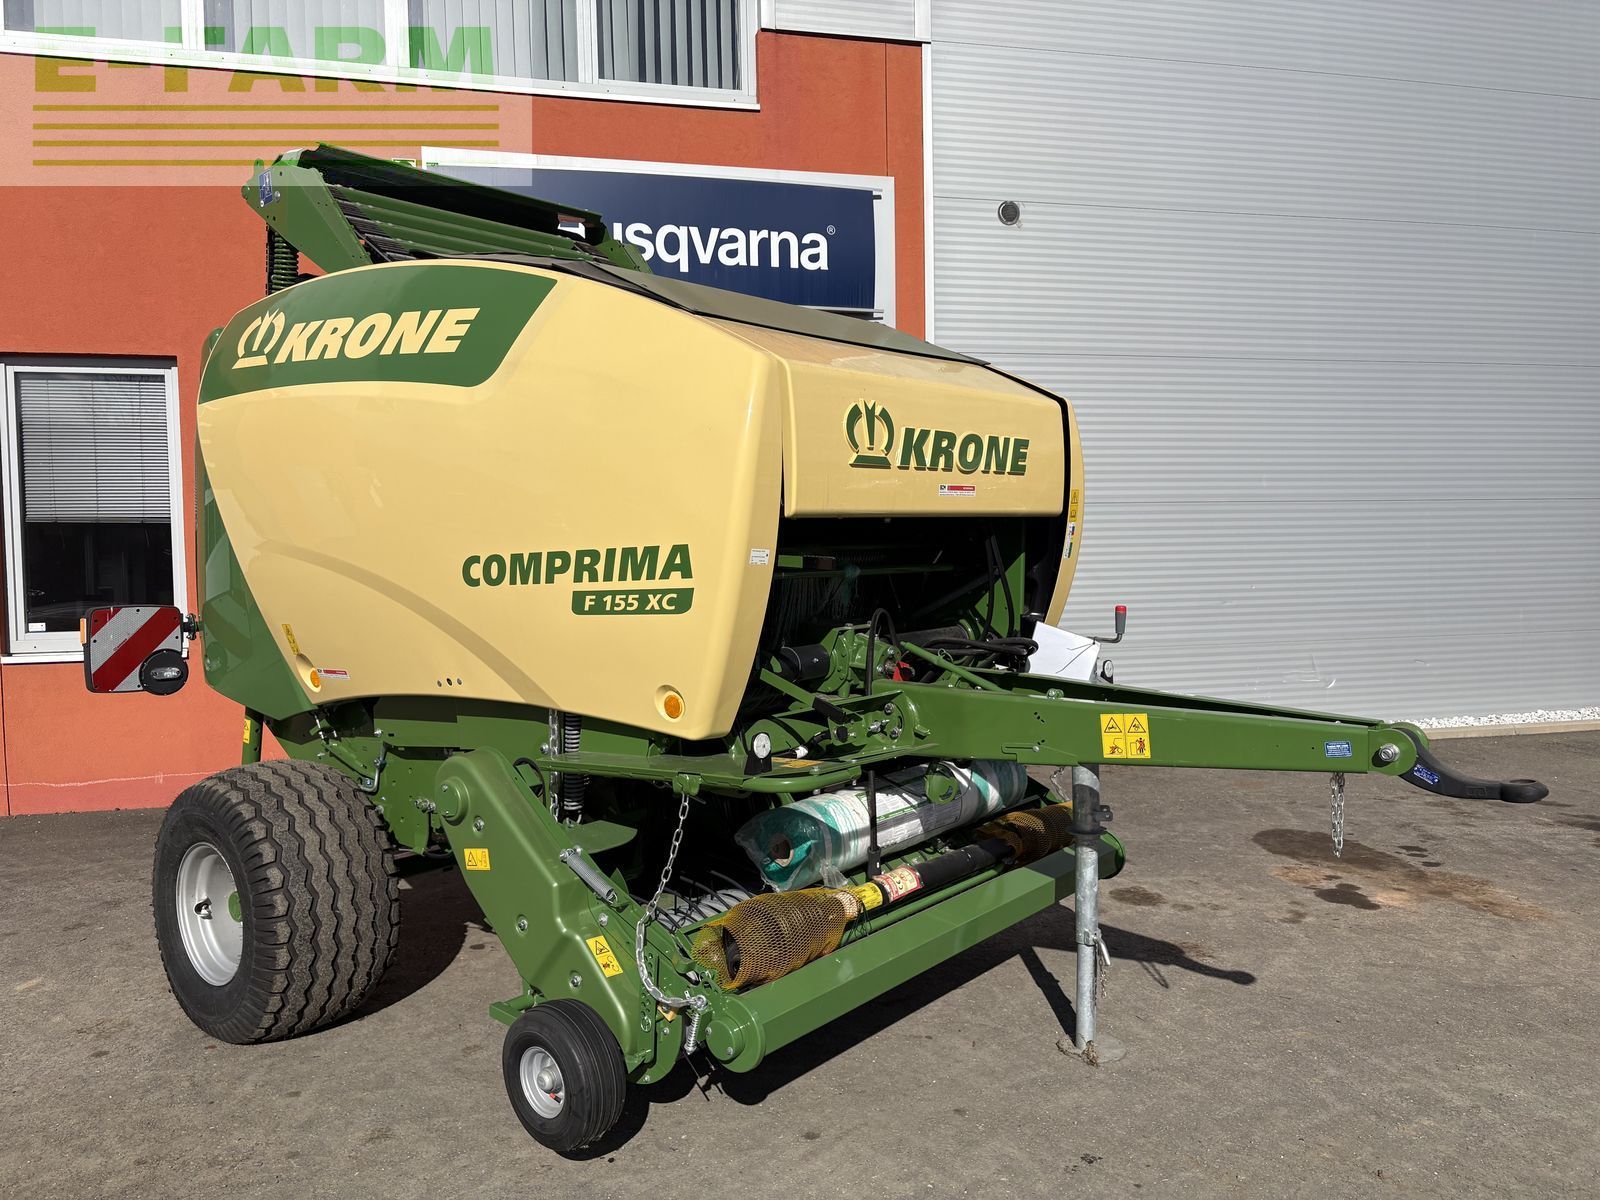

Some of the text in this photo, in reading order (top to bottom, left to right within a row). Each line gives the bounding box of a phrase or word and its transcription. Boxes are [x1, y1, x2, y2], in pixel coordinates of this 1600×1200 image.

[275, 307, 481, 364] KRONE
[898, 426, 1030, 476] KRONE
[462, 544, 693, 587] COMPRIMA
[584, 593, 677, 612] F 155 XC
